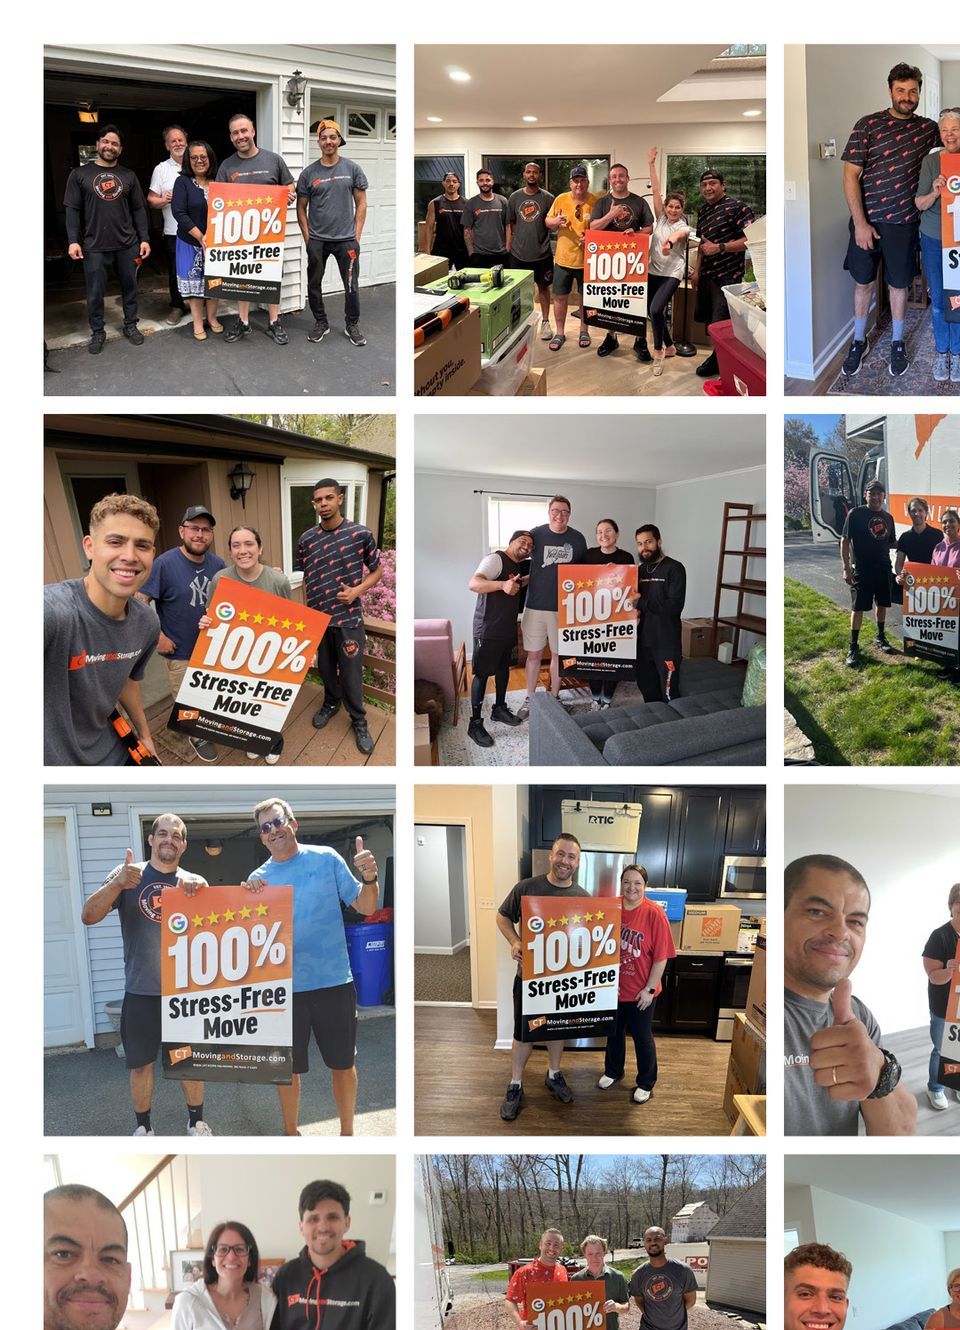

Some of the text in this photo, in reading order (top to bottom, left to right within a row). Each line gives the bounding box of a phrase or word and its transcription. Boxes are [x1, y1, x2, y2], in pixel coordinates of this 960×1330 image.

[211, 208, 282, 245] 100%
[209, 246, 280, 262] Stress-Free
[229, 263, 262, 275] Move
[587, 252, 644, 280] 100%
[586, 284, 644, 296] Stress-Free
[602, 297, 630, 308] Move
[562, 587, 633, 625] 100%
[906, 586, 957, 613] 100%
[563, 623, 633, 642] Stress-Free
[906, 617, 956, 629] Stress-Free
[920, 629, 943, 641] Move
[203, 622, 311, 674] 100%
[583, 641, 617, 654] Move
[189, 671, 292, 702] Stress-Free
[213, 695, 262, 717] Move
[198, 716, 271, 742] MovingandStorage.com
[589, 816, 614, 824] RTIC
[168, 921, 285, 988] 100%
[528, 923, 616, 974] 100%
[528, 969, 616, 997] Stress-Free
[169, 987, 286, 1019] Stress-Free
[555, 991, 596, 1010] Move
[204, 1014, 258, 1040] Move
[547, 1015, 614, 1025] MovingandStorage.com
[193, 1051, 286, 1063] MovingandStorage.com
